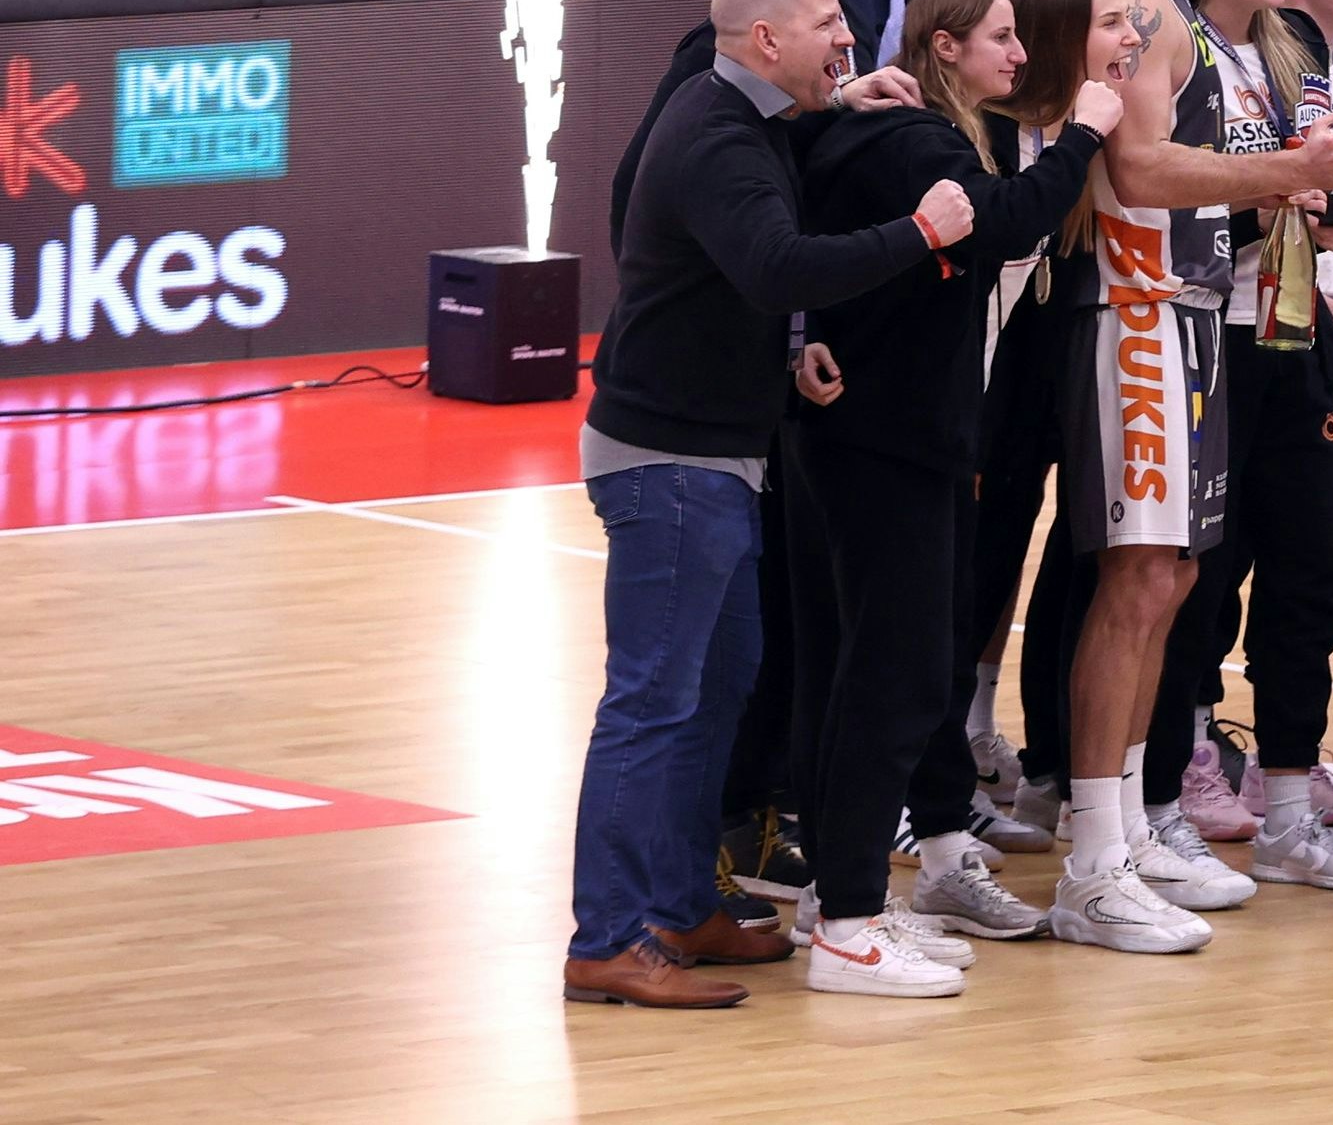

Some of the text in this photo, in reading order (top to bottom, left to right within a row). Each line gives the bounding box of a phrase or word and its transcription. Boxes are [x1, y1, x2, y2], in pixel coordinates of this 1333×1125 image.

[0, 55, 88, 200] k
[124, 56, 280, 118] IMMO
[0, 202, 289, 346] ukes
